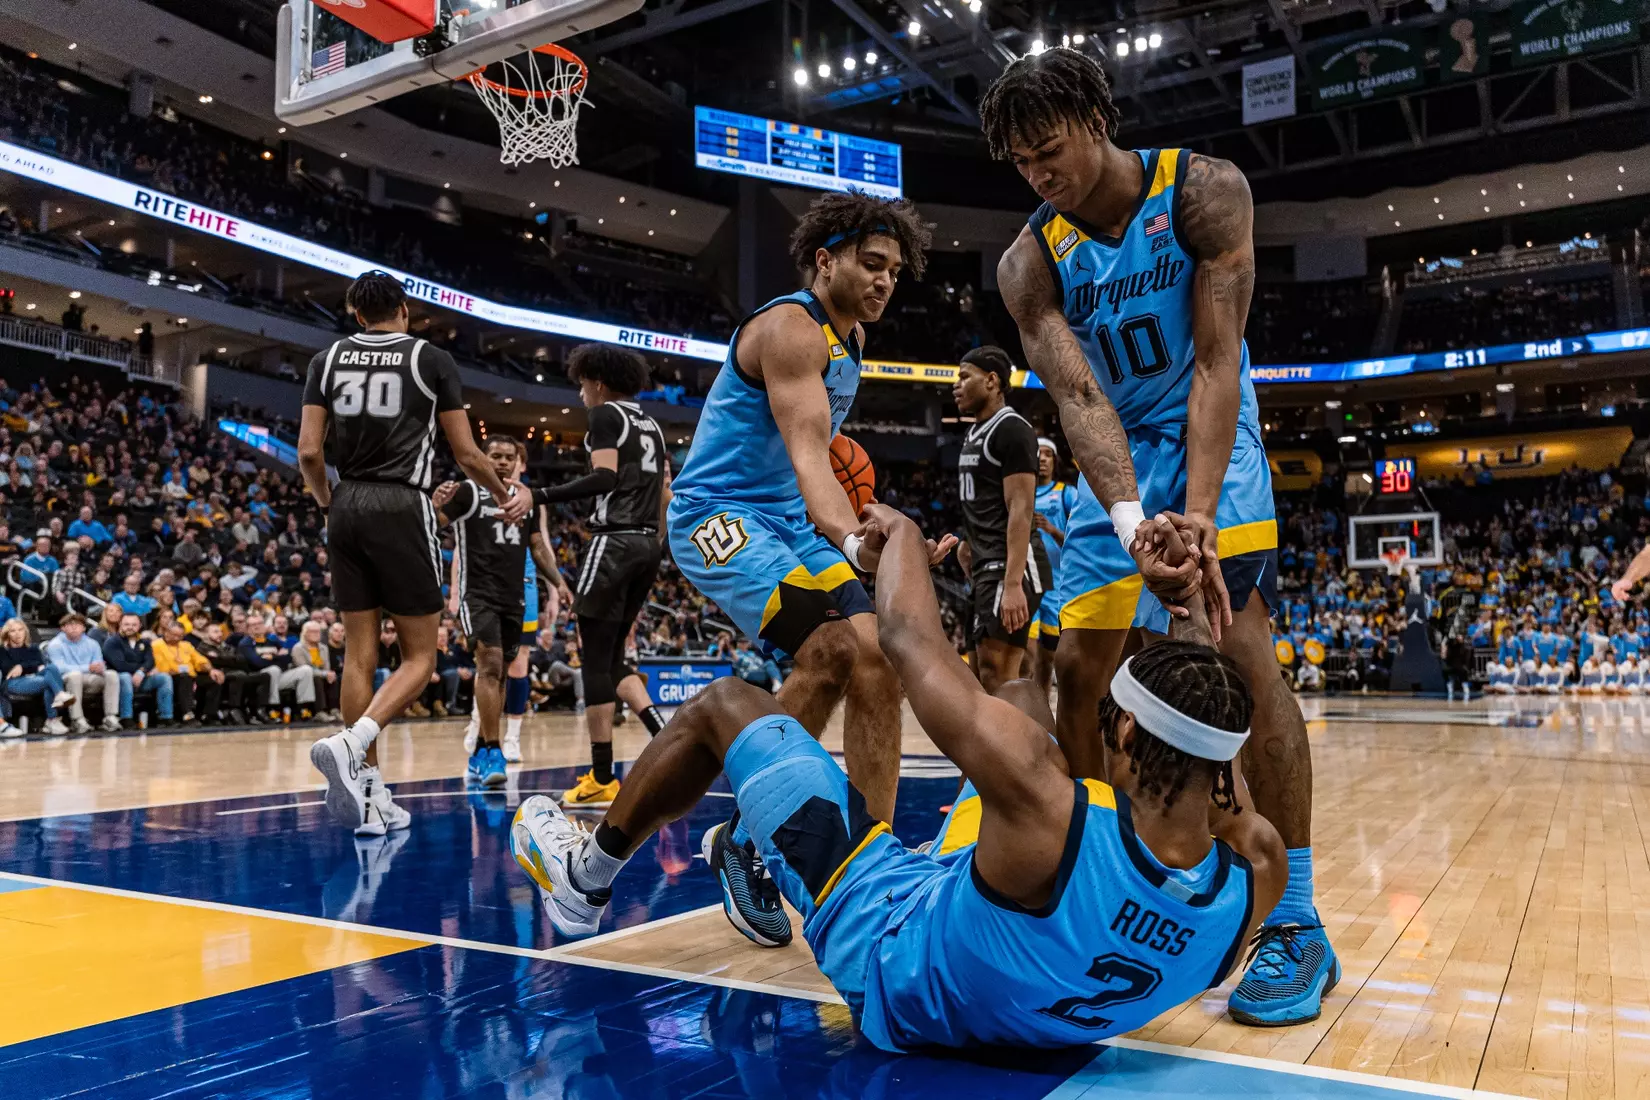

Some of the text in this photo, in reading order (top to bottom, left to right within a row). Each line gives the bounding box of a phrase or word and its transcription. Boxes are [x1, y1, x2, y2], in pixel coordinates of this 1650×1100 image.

[1519, 20, 1632, 56] WORLD CHAMPIONS
[1319, 66, 1417, 100] WORLD CHAMPIONS
[134, 190, 240, 237] RITEHITE
[404, 278, 475, 312] RITEHITE
[1069, 252, 1185, 314] Mrquette
[338, 350, 404, 366] CASTRO
[618, 330, 688, 353] RITEHITE
[1096, 312, 1172, 385] 10
[1444, 349, 1487, 368] 2:11
[1524, 338, 1563, 359] 2nd
[1250, 366, 1312, 381] ARQUETTE
[332, 370, 404, 418] 30
[640, 434, 658, 473] 2
[1380, 472, 1411, 493] 30
[492, 521, 521, 545] 14
[690, 512, 750, 569] MU
[659, 683, 708, 703] GRUB
[1110, 898, 1196, 957] ROSS
[1033, 952, 1163, 1031] 2
